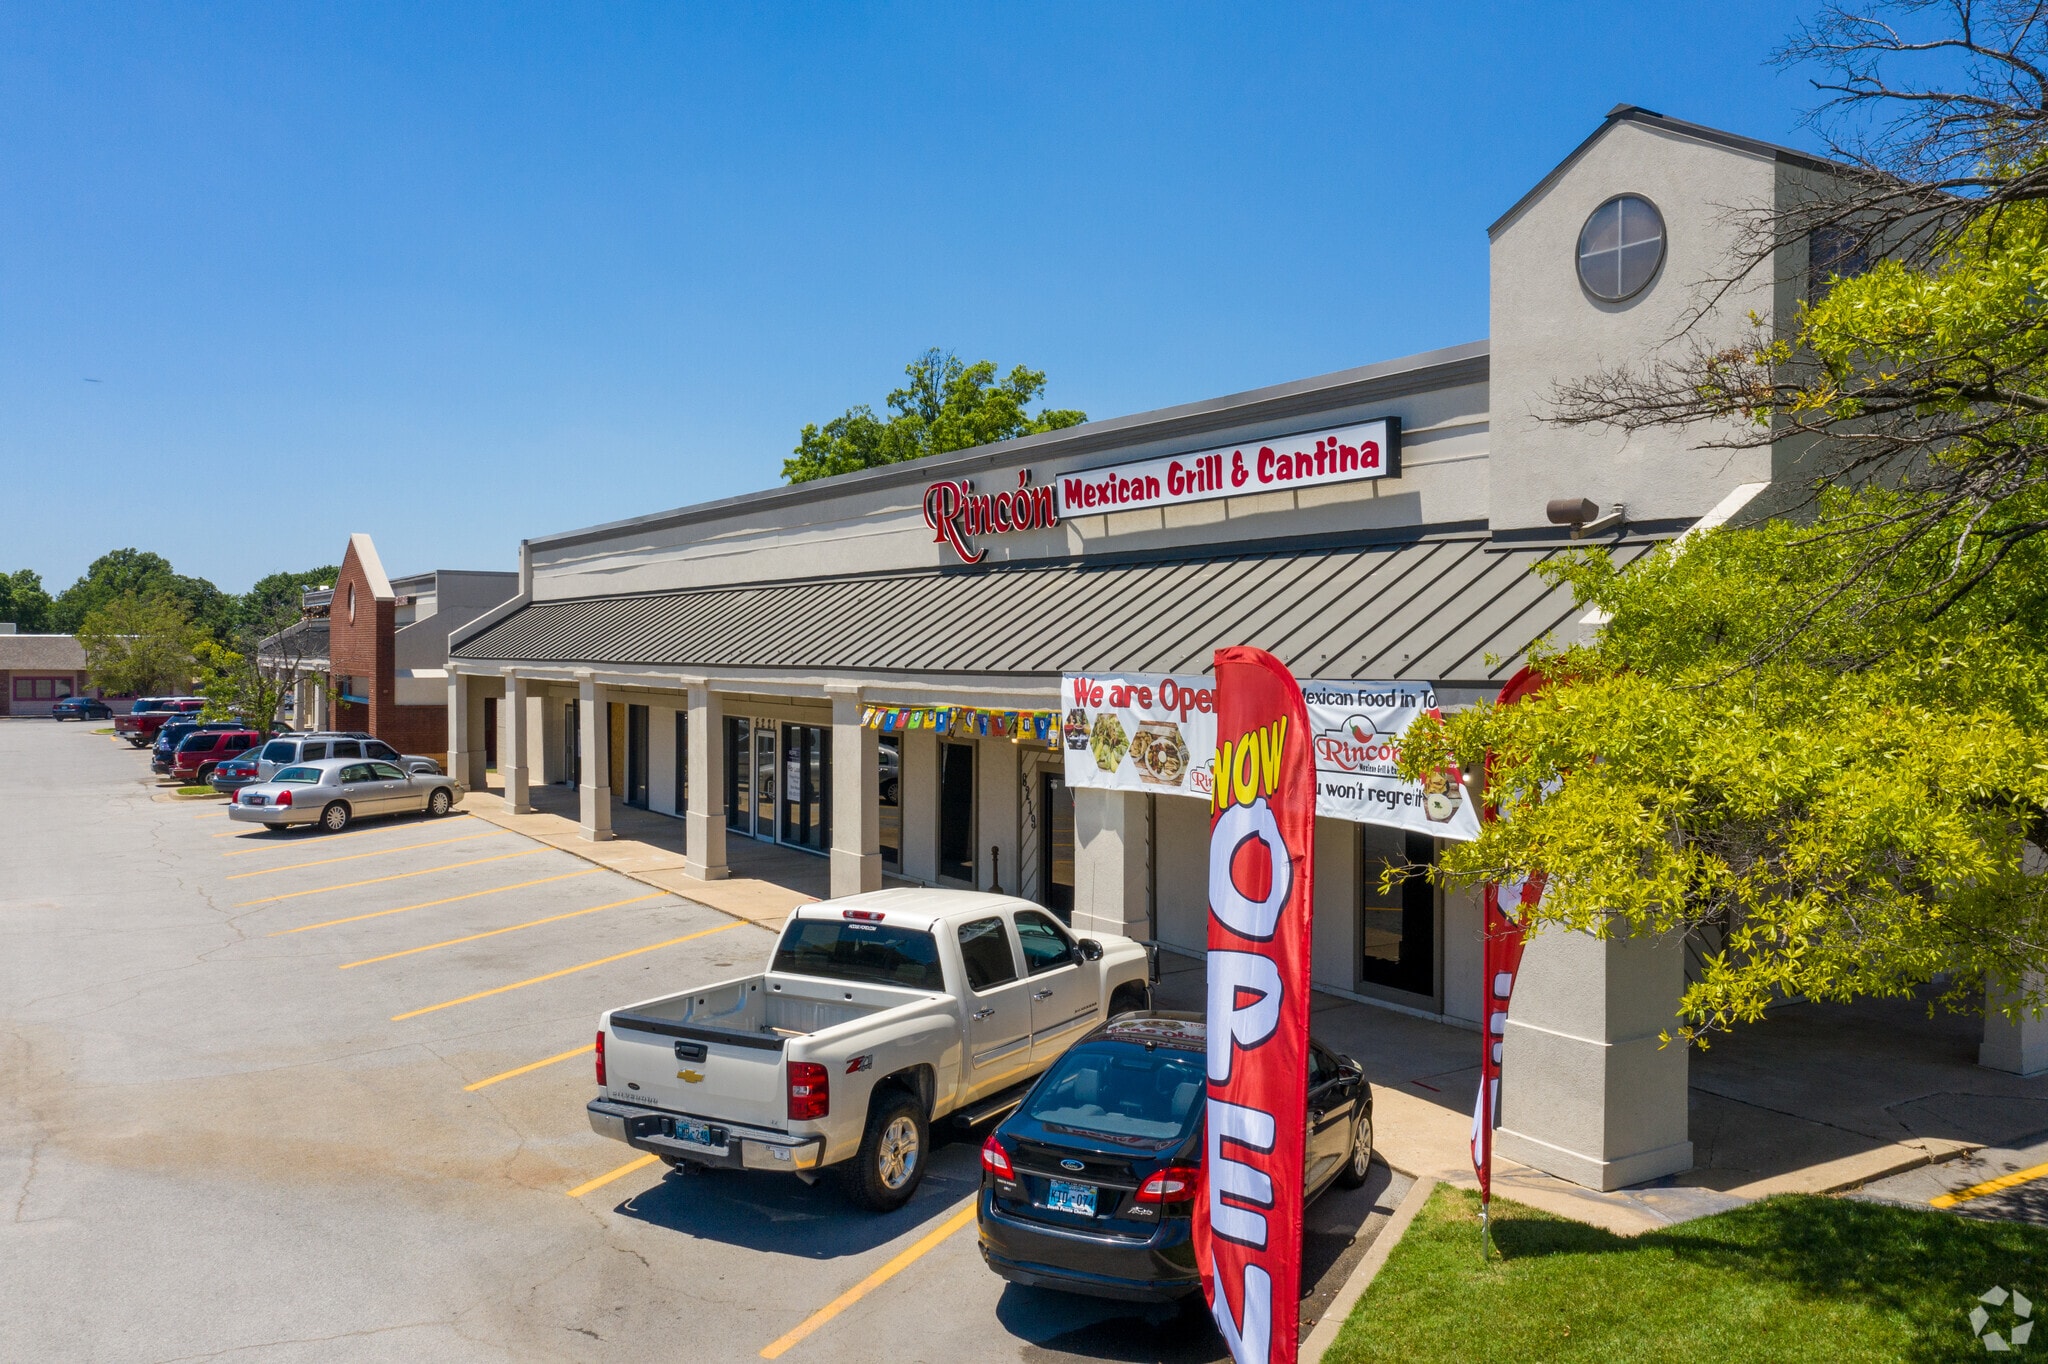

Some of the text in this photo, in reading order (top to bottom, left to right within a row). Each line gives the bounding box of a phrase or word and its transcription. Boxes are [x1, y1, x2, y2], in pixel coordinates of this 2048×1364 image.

[1064, 436, 1379, 509] Mexican Grill & Cantina
[923, 469, 1058, 564] Rincón
[1073, 677, 1104, 708] We
[1109, 685, 1153, 709] are
[1358, 689, 1397, 708] Food
[1401, 689, 1416, 708] in
[1211, 715, 1288, 817] NOW
[1391, 765, 1399, 775] Ca
[1022, 772, 1036, 829] 8219
[1326, 782, 1364, 800] won't
